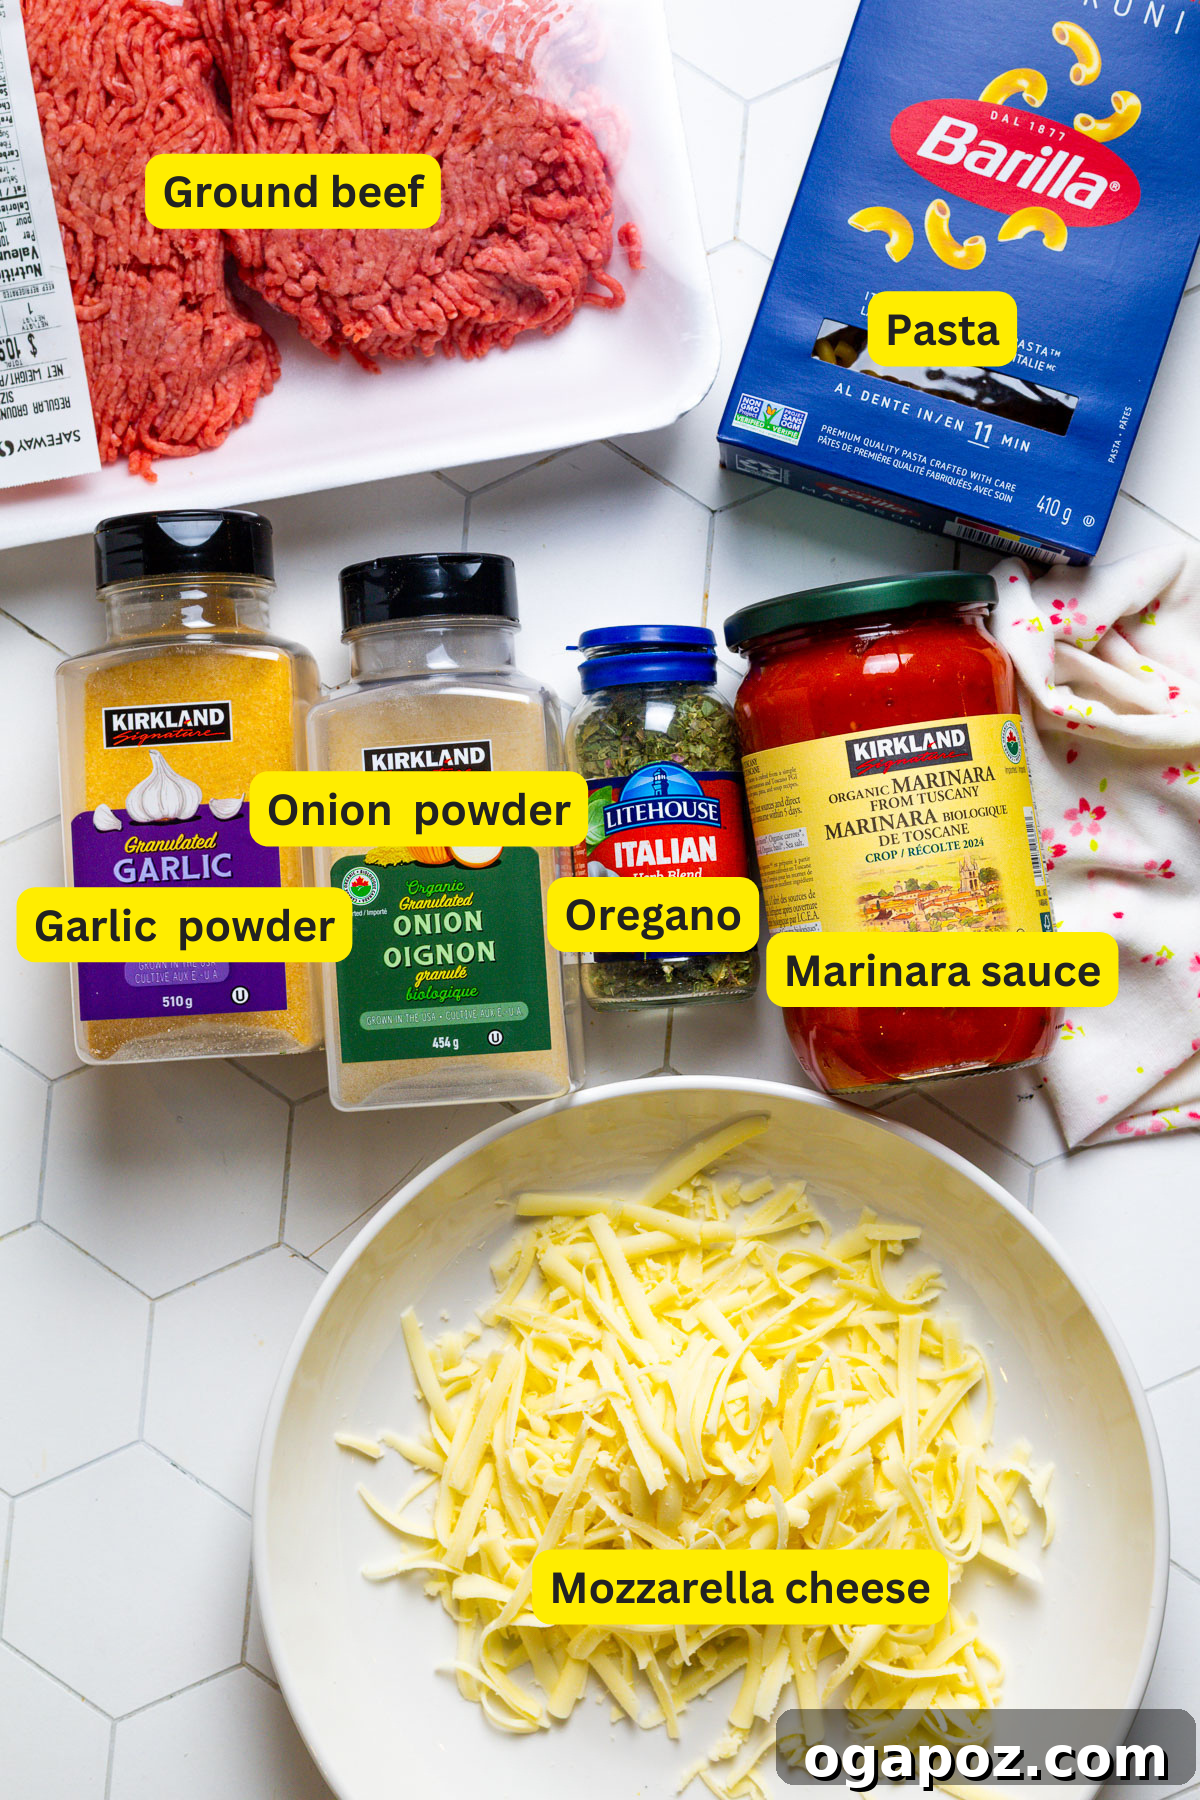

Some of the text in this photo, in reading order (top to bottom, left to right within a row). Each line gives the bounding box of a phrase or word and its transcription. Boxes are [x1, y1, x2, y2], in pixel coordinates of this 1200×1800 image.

[1083, 0, 1185, 34] ONI
[990, 110, 1066, 141] DAL 1877
[0, 199, 30, 213] Calorie
[15, 214, 33, 227] pour
[22, 230, 36, 242] Per
[0, 262, 42, 283] Nutriti
[27, 332, 39, 358] $
[47, 363, 64, 377] NET
[0, 396, 71, 421] REGULAR GROUN
[740, 403, 760, 413] GMO
[742, 396, 762, 408] NON
[784, 409, 804, 418] PROJET
[736, 414, 765, 428] VERIFIED
[780, 421, 801, 432] OGM
[782, 413, 803, 425] SANS
[834, 382, 1031, 453] AL DENTE IN/EN 11 MIN
[17, 429, 82, 452] SAFEWAY
[1108, 406, 1132, 464] PASTA PÂTES
[817, 435, 1013, 504] PÂTES DE PREMIÈRE QUALITÉ FABRIQUÉES AVEC SOIN
[821, 424, 1017, 493] PREMIUM QUALITY PASTA CRAFTED WITH CARE
[1036, 495, 1073, 526] 410 g
[112, 708, 225, 732] KIRKLAND
[112, 728, 226, 746] Signature
[853, 729, 966, 762] KIRKLAND
[371, 747, 485, 771] KIRKLAND
[856, 751, 969, 775] Signature
[828, 765, 996, 805] ORGANIC MARINARA
[785, 796, 801, 807] direct
[870, 785, 979, 812] FROM TUSCANY
[605, 800, 719, 829] LITEHOUSE
[824, 804, 1008, 841] MARINARA BIOLOGIQUE
[124, 832, 219, 854] Granulated
[879, 823, 970, 847] DE TOSCANE
[613, 836, 717, 869] ITALIAN
[866, 850, 898, 864] CROP
[908, 840, 961, 857] RÉCOLTE
[963, 838, 985, 849] 2024
[113, 853, 233, 884] GARLIC
[406, 880, 465, 897] Organic
[399, 892, 474, 911] Granulated
[393, 910, 484, 937] ONION
[383, 940, 496, 968] OIGNON
[415, 964, 467, 988] granulé
[162, 995, 193, 1009] 510 g
[405, 985, 479, 1003] biologique
[366, 1014, 392, 1026] GROWN
[394, 1014, 404, 1023] IN
[404, 1013, 418, 1023] THE
[421, 1012, 436, 1022] USA
[432, 1036, 460, 1050] 454 g
